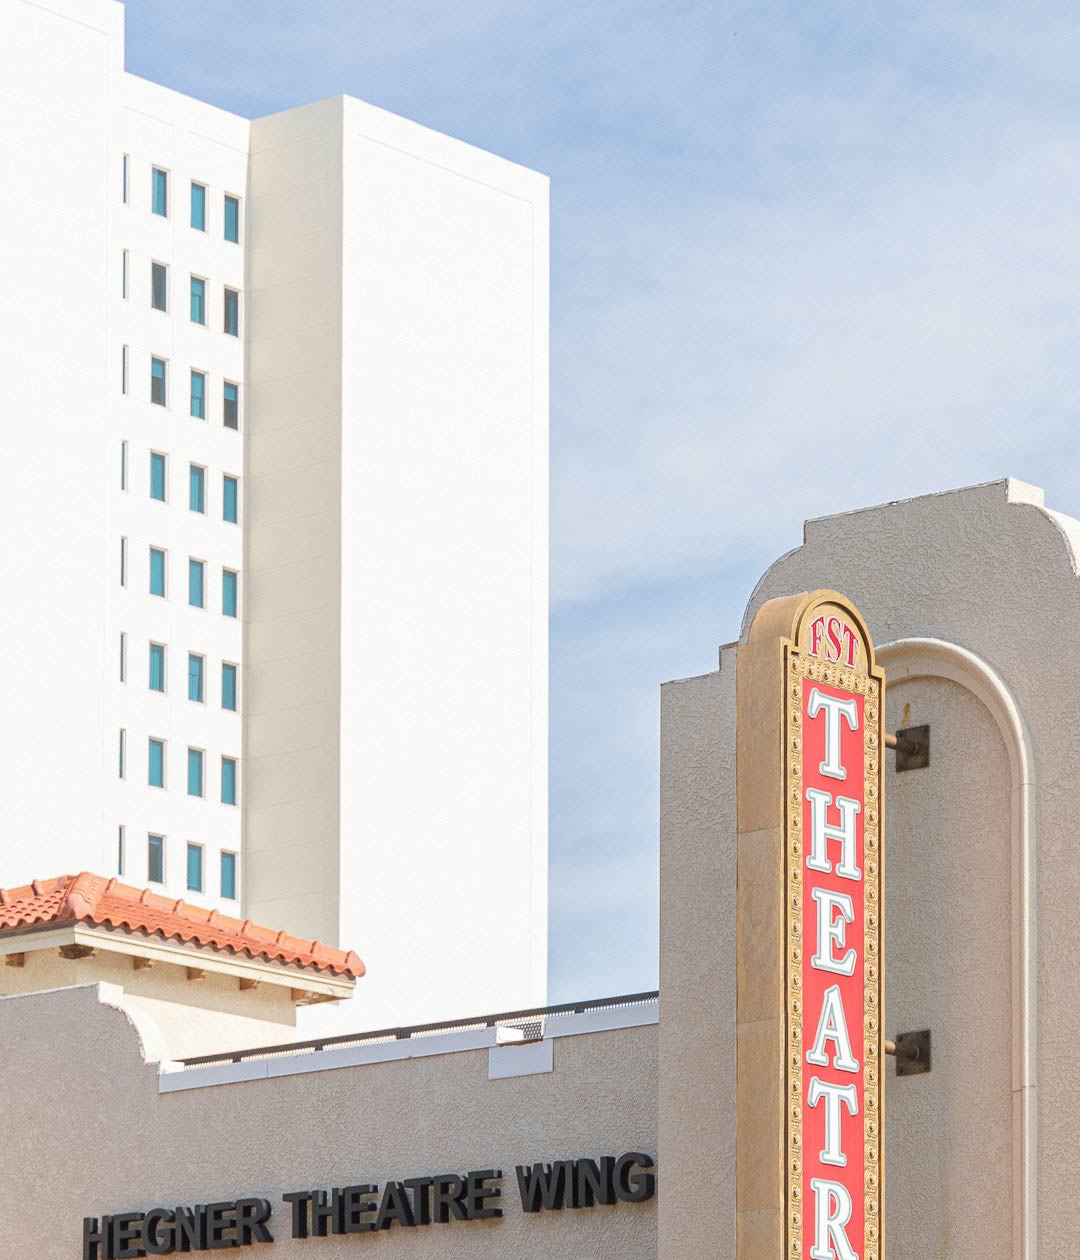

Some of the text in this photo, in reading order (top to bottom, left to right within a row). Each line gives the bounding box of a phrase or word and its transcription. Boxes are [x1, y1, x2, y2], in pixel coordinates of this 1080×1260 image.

[808, 615, 859, 668] FST
[282, 1168, 504, 1239] THEATRE
[515, 1151, 656, 1213] WING
